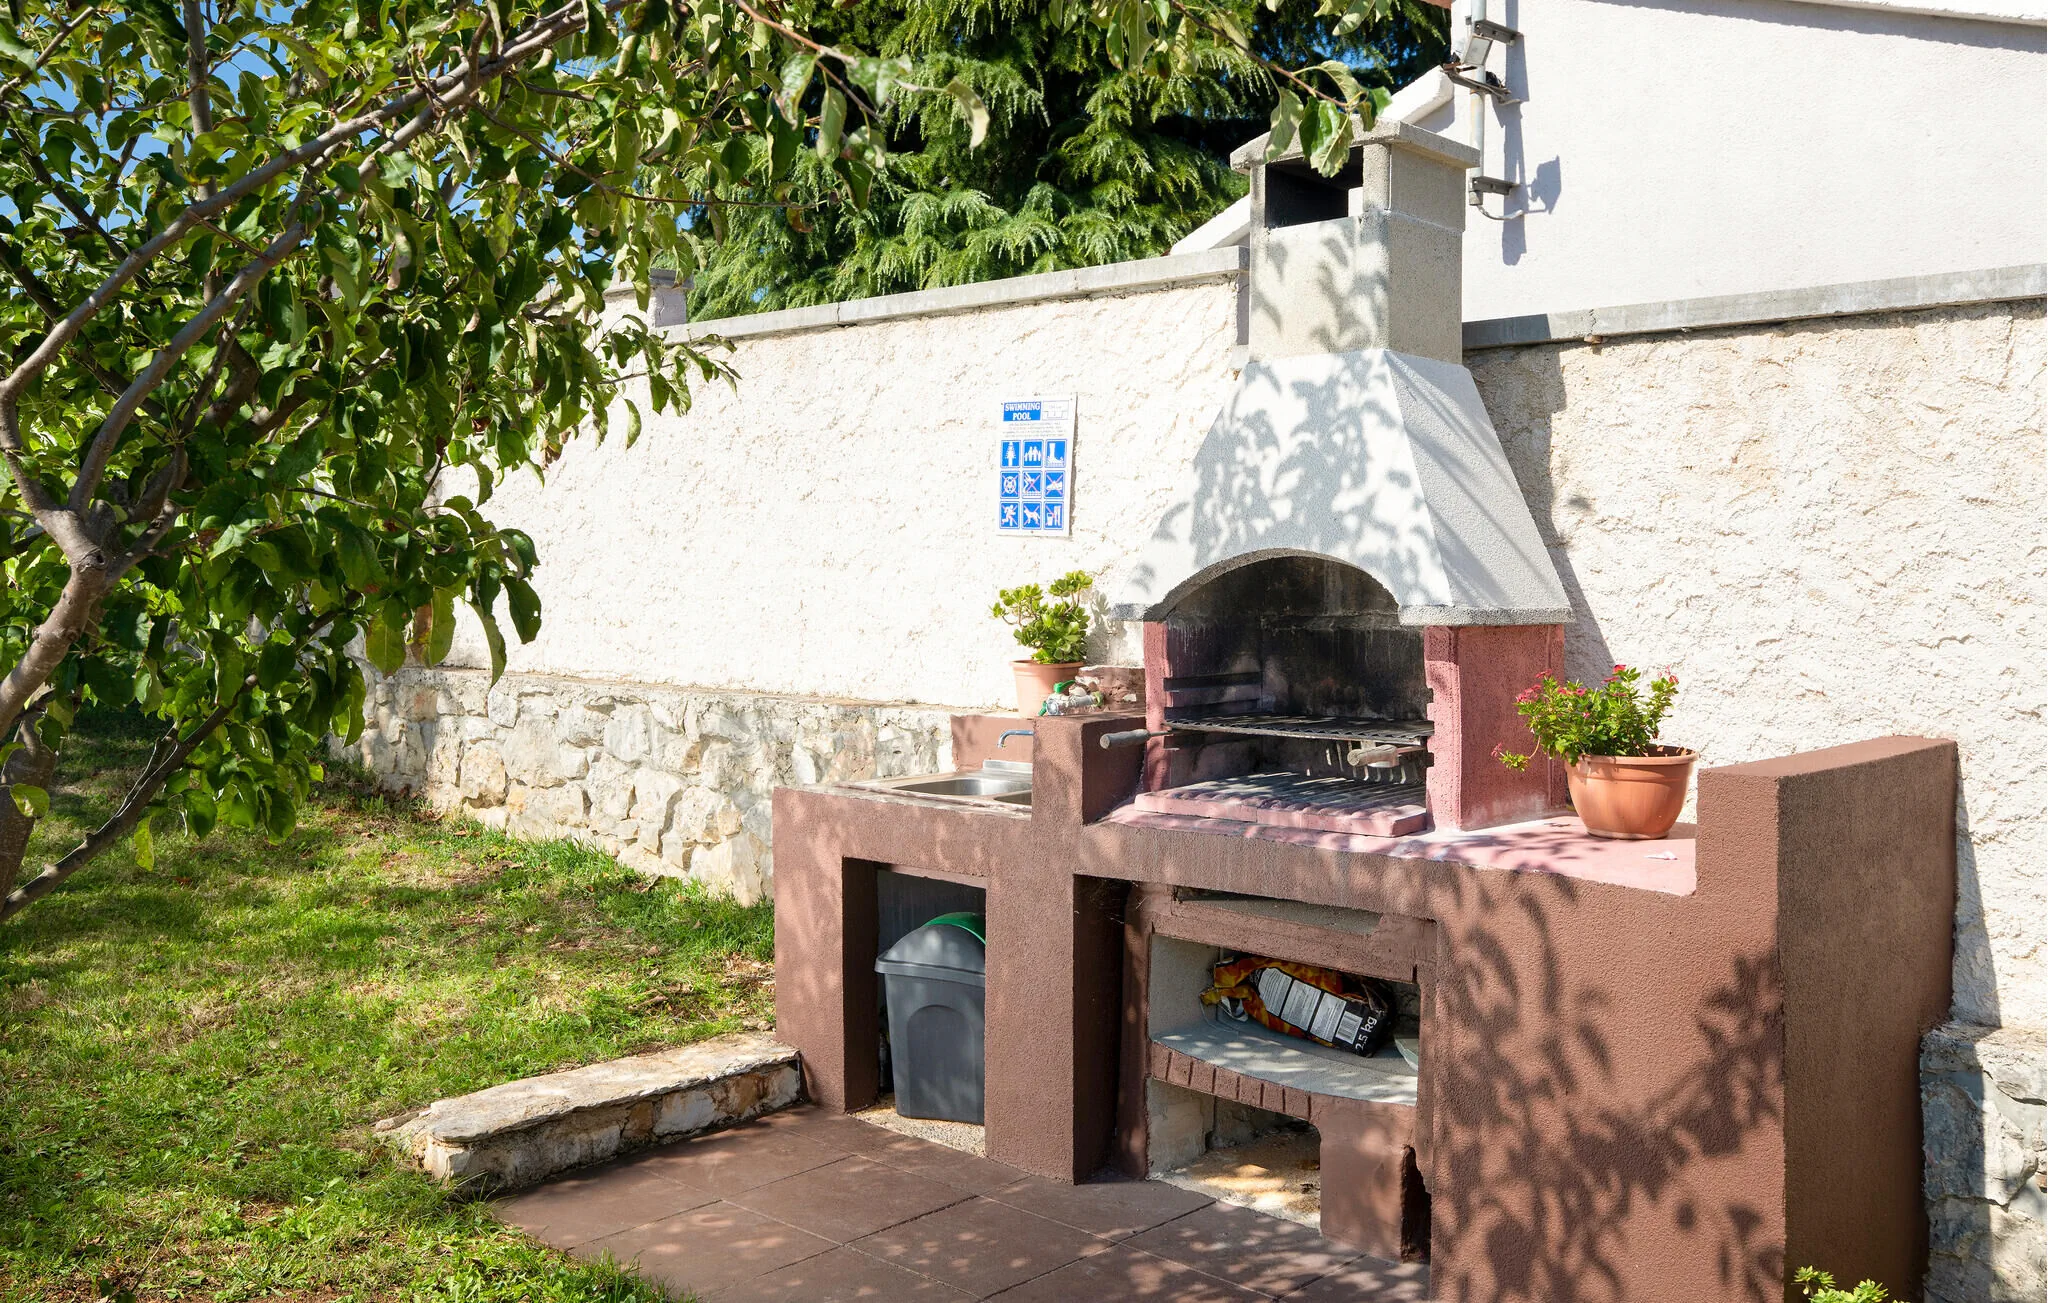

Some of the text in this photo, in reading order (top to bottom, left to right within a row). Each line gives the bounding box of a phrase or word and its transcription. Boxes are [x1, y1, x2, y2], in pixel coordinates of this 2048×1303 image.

[1005, 402, 1041, 412] SWIMMING
[1012, 412, 1032, 420] POOL
[1360, 1016, 1377, 1032] kg
